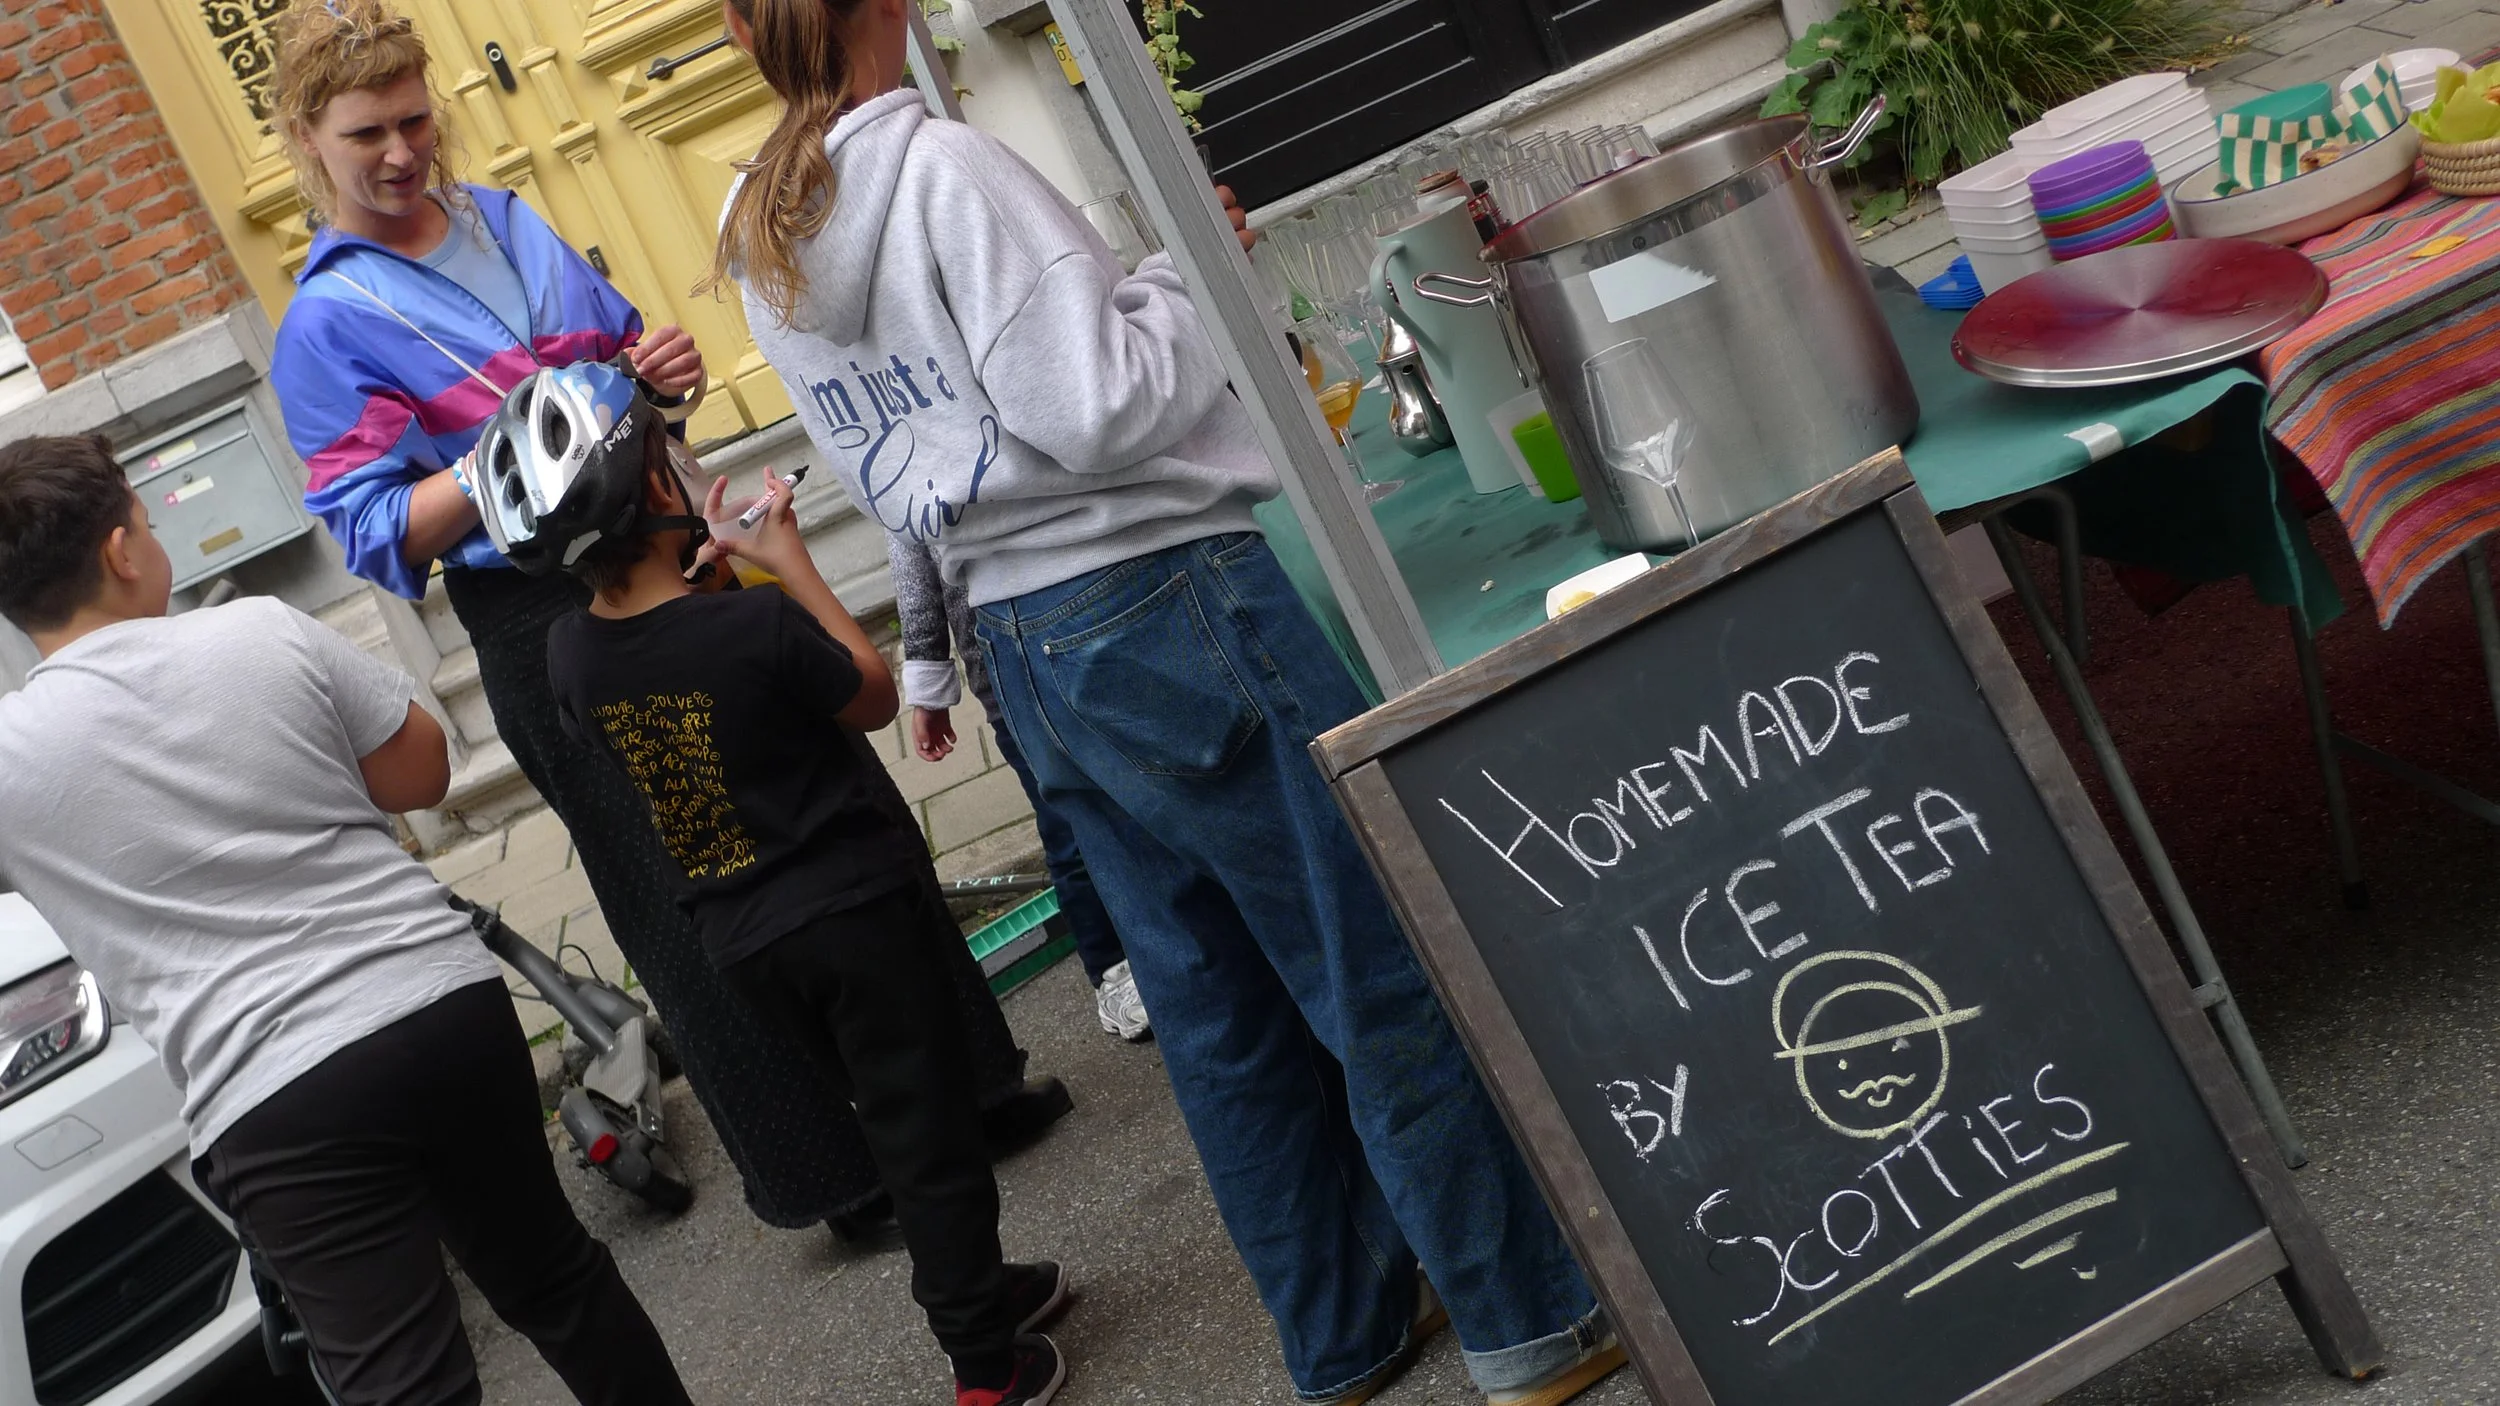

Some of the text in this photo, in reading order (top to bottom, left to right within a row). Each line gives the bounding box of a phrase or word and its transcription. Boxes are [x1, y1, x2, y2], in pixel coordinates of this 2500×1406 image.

[604, 412, 633, 453] MET
[849, 355, 933, 433] just
[926, 356, 959, 401] a
[831, 414, 999, 544] Girl
[1438, 650, 1911, 908] HOMEMADE
[1633, 786, 1992, 1011] ICE TEA
[1597, 1063, 1689, 1163] BY
